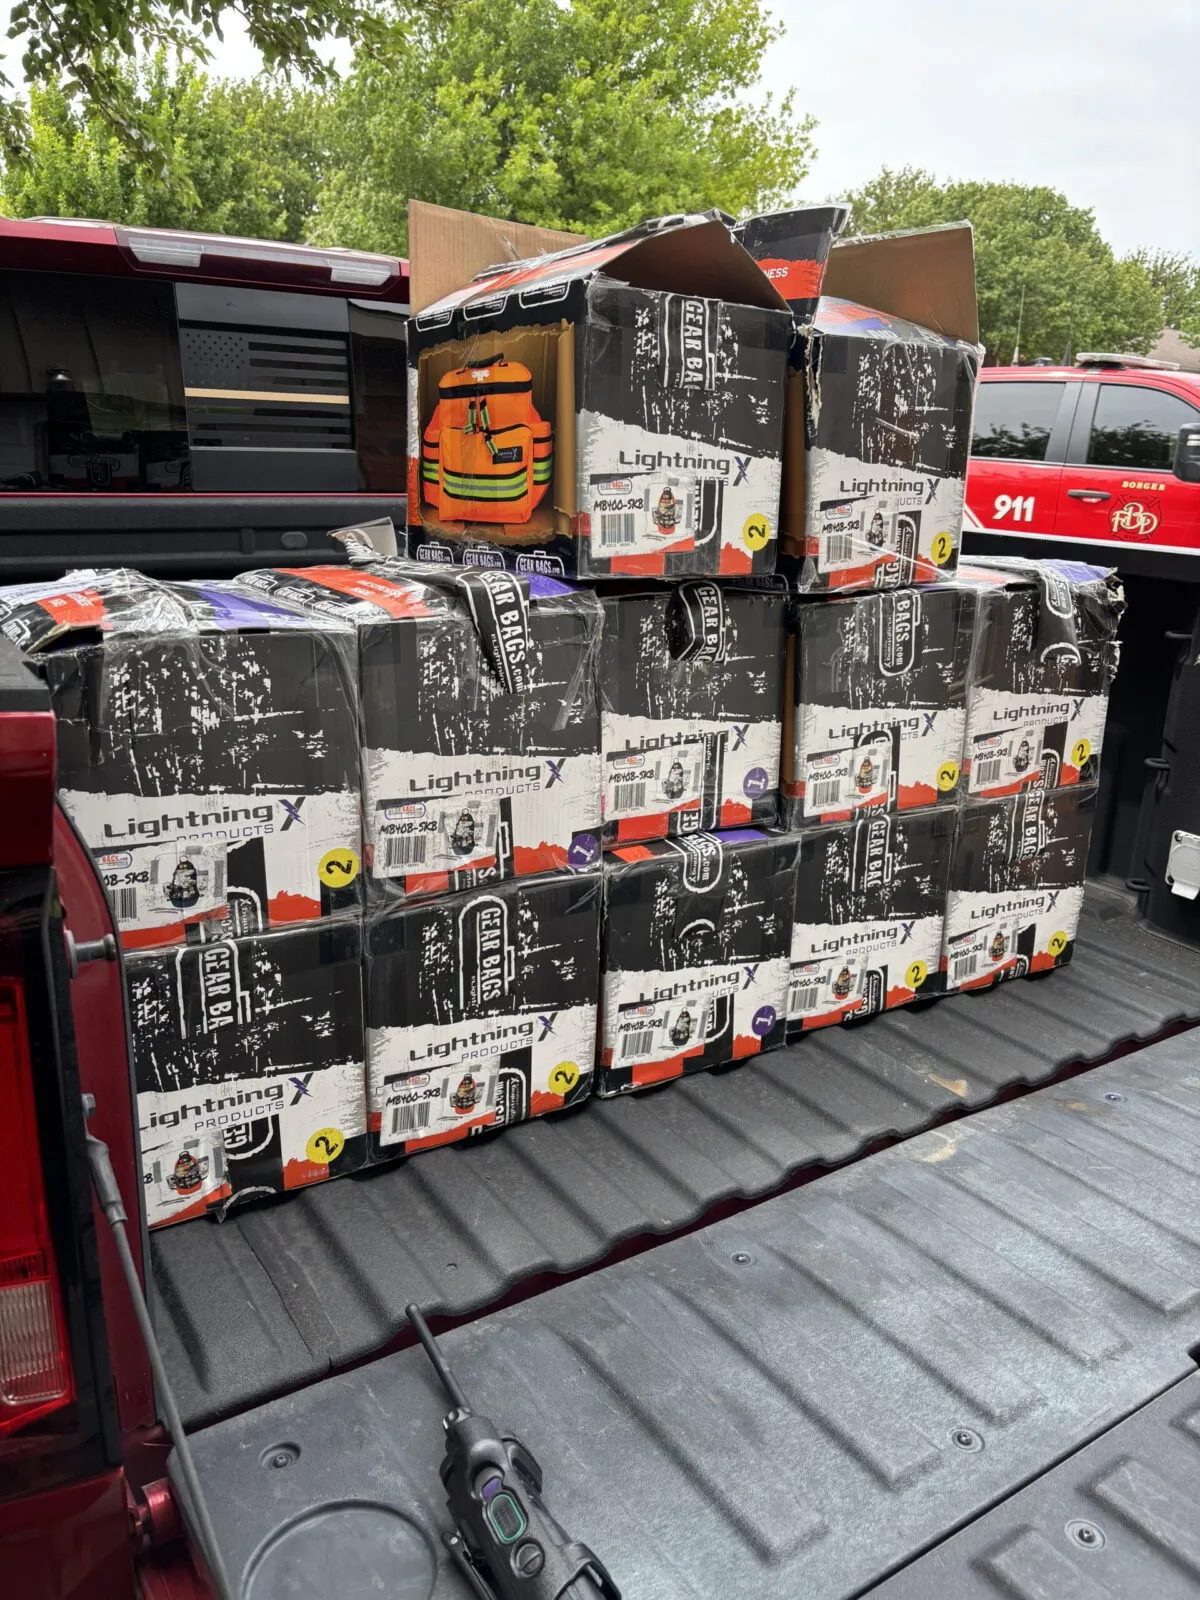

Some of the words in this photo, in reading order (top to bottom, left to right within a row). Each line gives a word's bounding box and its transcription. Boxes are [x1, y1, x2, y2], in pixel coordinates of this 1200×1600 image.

[684, 300, 702, 356] GEAR
[619, 449, 730, 476] Lightning
[839, 478, 924, 499] Lightning
[1121, 480, 1166, 491] BORGER
[992, 494, 1035, 522] 911
[748, 523, 766, 539] 2
[419, 548, 433, 561] GEAR
[938, 537, 947, 559] 2
[465, 554, 479, 567] GEAR
[519, 558, 535, 572] GEAR
[698, 586, 718, 627] GEAR
[480, 571, 514, 609] GEAR
[500, 612, 524, 693] BAGS.com
[896, 599, 910, 666] BAGS.com
[993, 702, 1070, 722] Lightning
[828, 717, 920, 739] Lightning
[1077, 743, 1087, 761] 2
[409, 765, 541, 794] Lightning
[747, 776, 765, 789] 1
[940, 768, 956, 781] 2
[1024, 791, 1041, 824] GEAR
[103, 803, 274, 839] Lightning
[682, 811, 699, 831] GE
[869, 820, 887, 858] GEAR
[572, 846, 595, 862] 1
[326, 859, 353, 875] 2
[971, 894, 1045, 920] Lightning
[480, 907, 501, 952] GEAR
[811, 925, 898, 955] Lightning
[1051, 937, 1063, 949] 2
[204, 948, 231, 998] GEAR
[482, 954, 502, 1002] BAGS
[912, 965, 922, 983] 2
[639, 971, 740, 1002] Lightning
[755, 1014, 773, 1026] 1
[409, 1021, 534, 1062] Lightning
[461, 1036, 534, 1062] PRODUCTS
[555, 1069, 575, 1085] 2
[194, 1100, 285, 1132] PRODUCTS
[315, 1136, 339, 1155] 2
